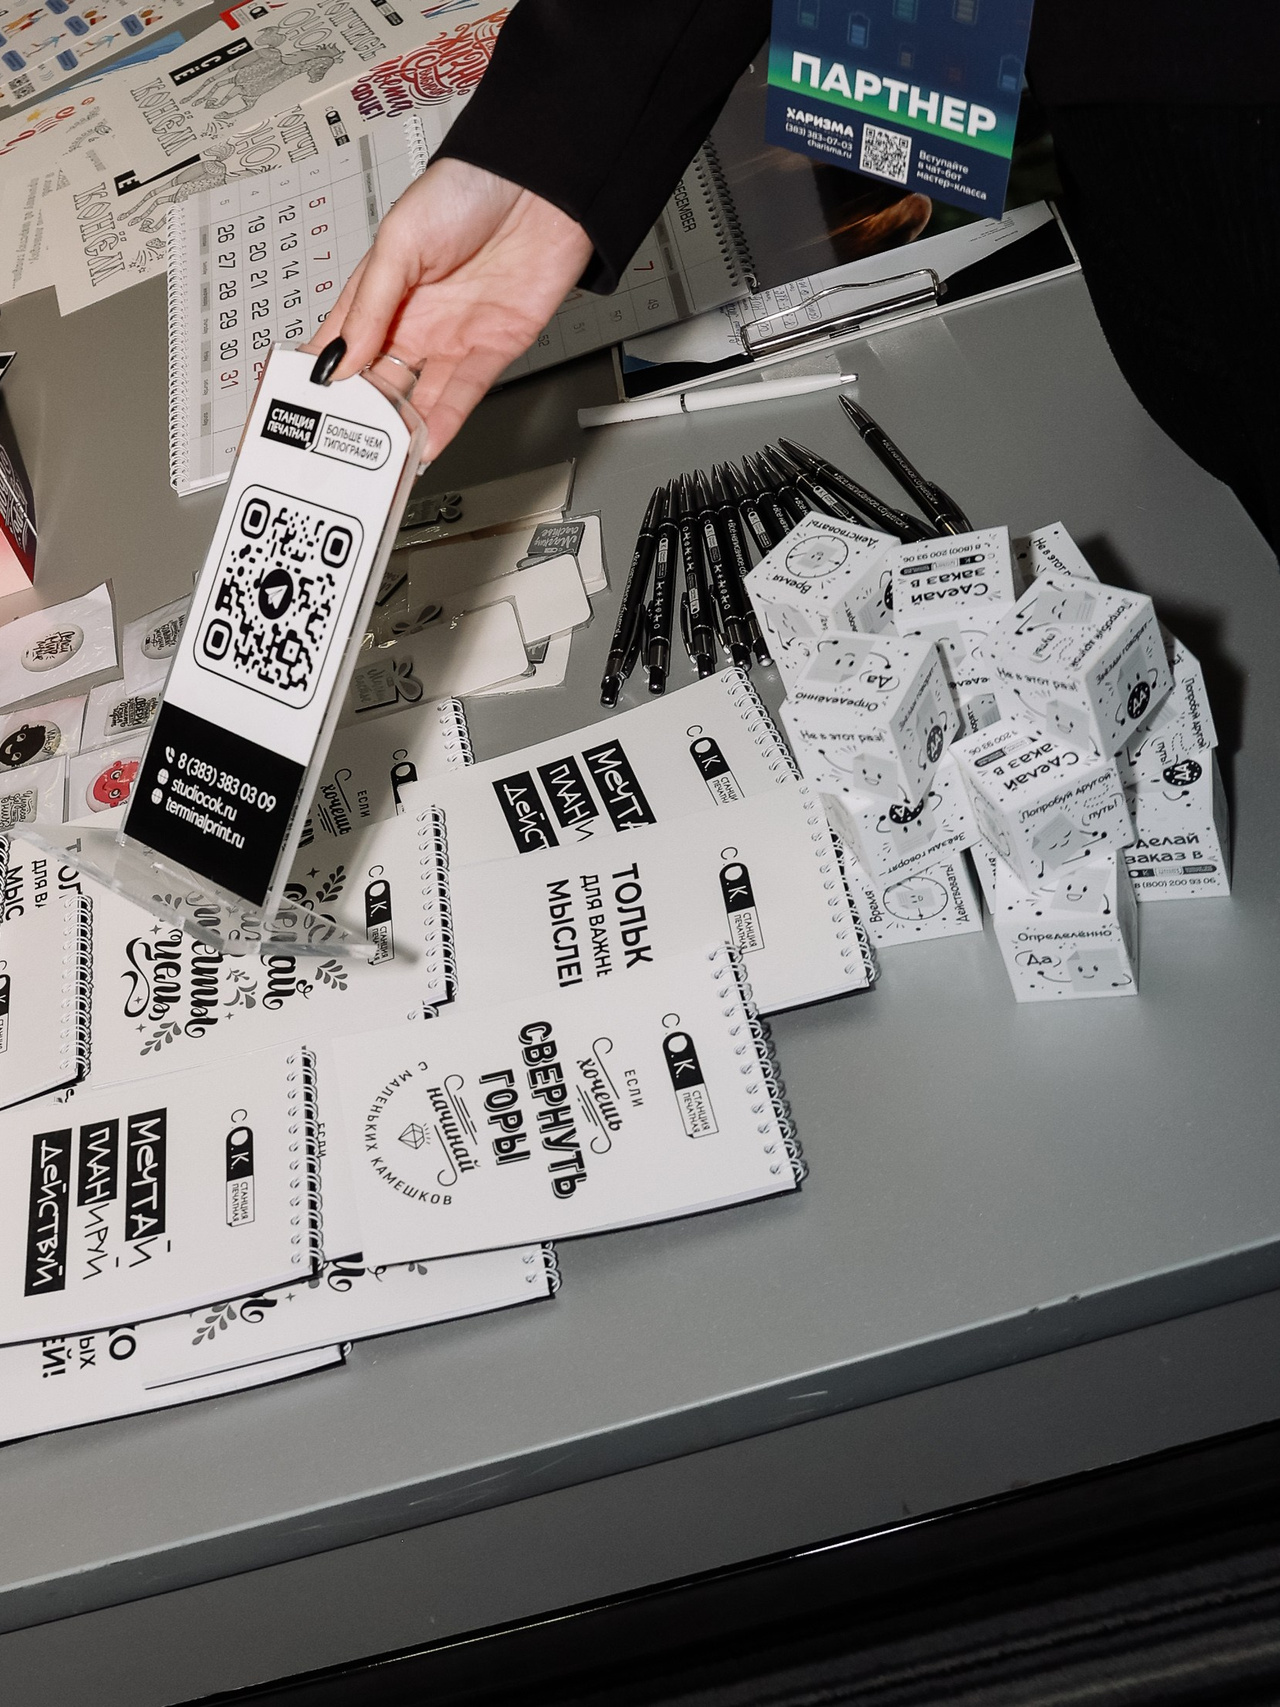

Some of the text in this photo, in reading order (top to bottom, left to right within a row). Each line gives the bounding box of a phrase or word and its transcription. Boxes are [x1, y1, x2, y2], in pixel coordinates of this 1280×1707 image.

[790, 50, 997, 138] ПАРТНЕР
[786, 107, 854, 138] ХАРИЗМА
[919, 150, 969, 175] Вступайте
[916, 171, 988, 200] мастер-класса
[217, 224, 235, 243] 26
[248, 215, 265, 233] 19
[249, 241, 266, 262] 20
[309, 197, 333, 293] 5 6 7 8
[218, 251, 236, 269] 27
[278, 205, 303, 339] 12 13 14 15 16
[219, 280, 237, 300] 28
[250, 270, 268, 289] 21
[220, 309, 237, 330] 29
[252, 298, 269, 320] 22
[220, 339, 238, 361] 30
[252, 328, 270, 350] 23
[221, 369, 239, 389] 31
[267, 420, 311, 443] ПЕЧАТНАЯ
[271, 407, 315, 431] СТАНЦИЯ
[323, 437, 379, 462] ТИПОГРАФИЯ
[326, 424, 383, 450] БОЛЬШЕ ЧЕМ
[772, 573, 812, 595] Время
[910, 567, 985, 588] заказ в
[911, 583, 988, 605] Сделай
[867, 675, 892, 688] Да
[795, 692, 878, 711] Определённо
[993, 743, 1058, 776] аказ в
[1004, 752, 1079, 791] Сделай
[177, 752, 276, 813] 8 (383) 383 03 09
[713, 780, 730, 804] ПЕЧАТН
[720, 776, 739, 802] СТАНЦИ
[1021, 772, 1111, 821] Попробуй другой
[171, 778, 238, 821] studiocok.ru
[321, 784, 352, 836] хочешь
[357, 789, 370, 818] ЕСЛИ
[1088, 799, 1118, 820] путь!
[165, 796, 245, 849] terminalprint.ru
[1122, 832, 1200, 849] делай
[1125, 850, 1203, 865] заказ в
[32, 859, 48, 893] ДЛЯ
[612, 862, 653, 969] ТОЛЬК
[868, 890, 883, 923] Время
[546, 879, 583, 988] МЫСЛЕ
[580, 874, 613, 978] ДЛЯ ВАЖН
[743, 912, 757, 948] СТАНЦИЯ
[1018, 928, 1112, 943] Определённо
[1027, 954, 1052, 966] Да
[576, 1057, 623, 1132] хочешь
[623, 1068, 645, 1109] ЕСЛИ
[364, 1070, 414, 1153] МАЛЕНЬКИХ
[479, 1067, 532, 1166] ГОРЫ
[518, 1019, 588, 1200] СВЕРНУТЬ
[681, 1092, 701, 1136] ПЕЧАТНАЯ
[691, 1090, 710, 1132] СТАНЦИЯ
[426, 1086, 482, 1174] начинай
[370, 1156, 453, 1206] КАМЕШКОВ
[231, 1182, 241, 1223] ПЕЧАТНАЯ
[240, 1181, 249, 1222] СТАНЦИЯ
